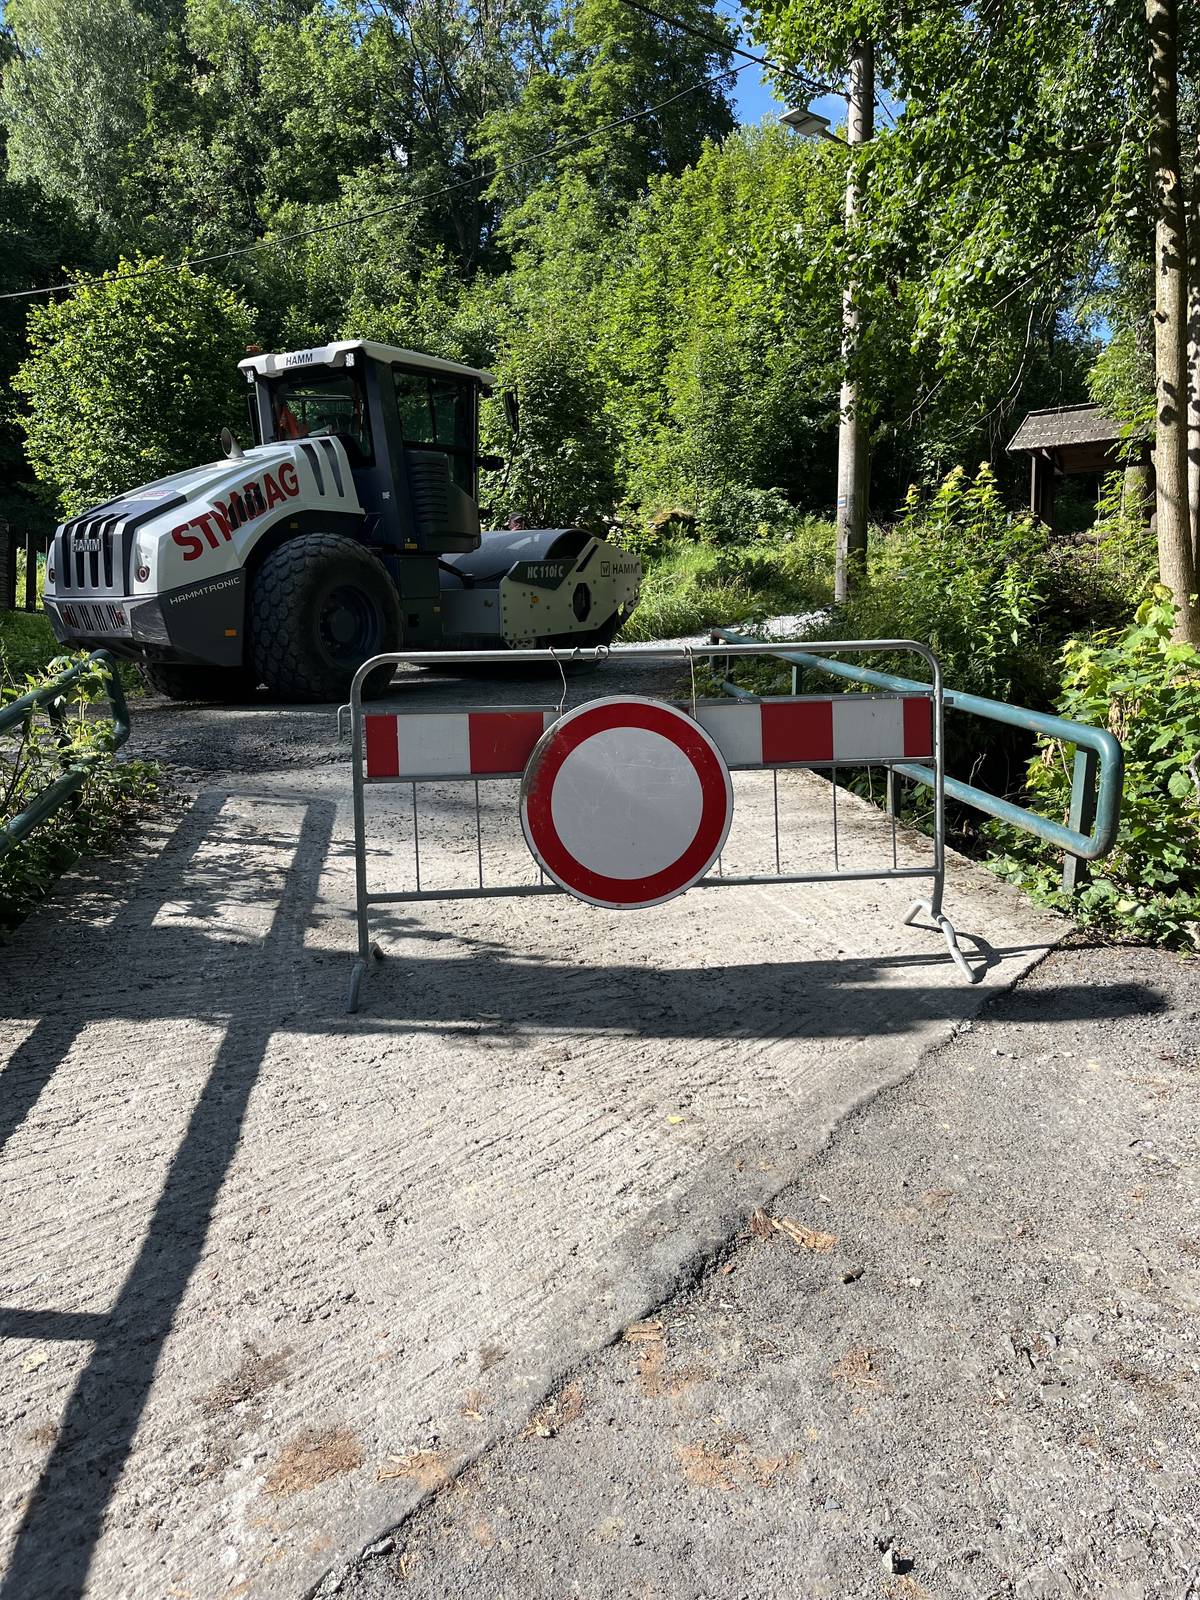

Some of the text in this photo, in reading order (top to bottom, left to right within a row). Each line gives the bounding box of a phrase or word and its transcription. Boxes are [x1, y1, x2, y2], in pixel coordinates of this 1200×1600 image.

[286, 353, 313, 366] HAMM
[72, 538, 101, 552] HAMM
[527, 566, 538, 579] HC
[612, 563, 638, 575] HAMM
[169, 576, 241, 606] HAMMTRONIC
